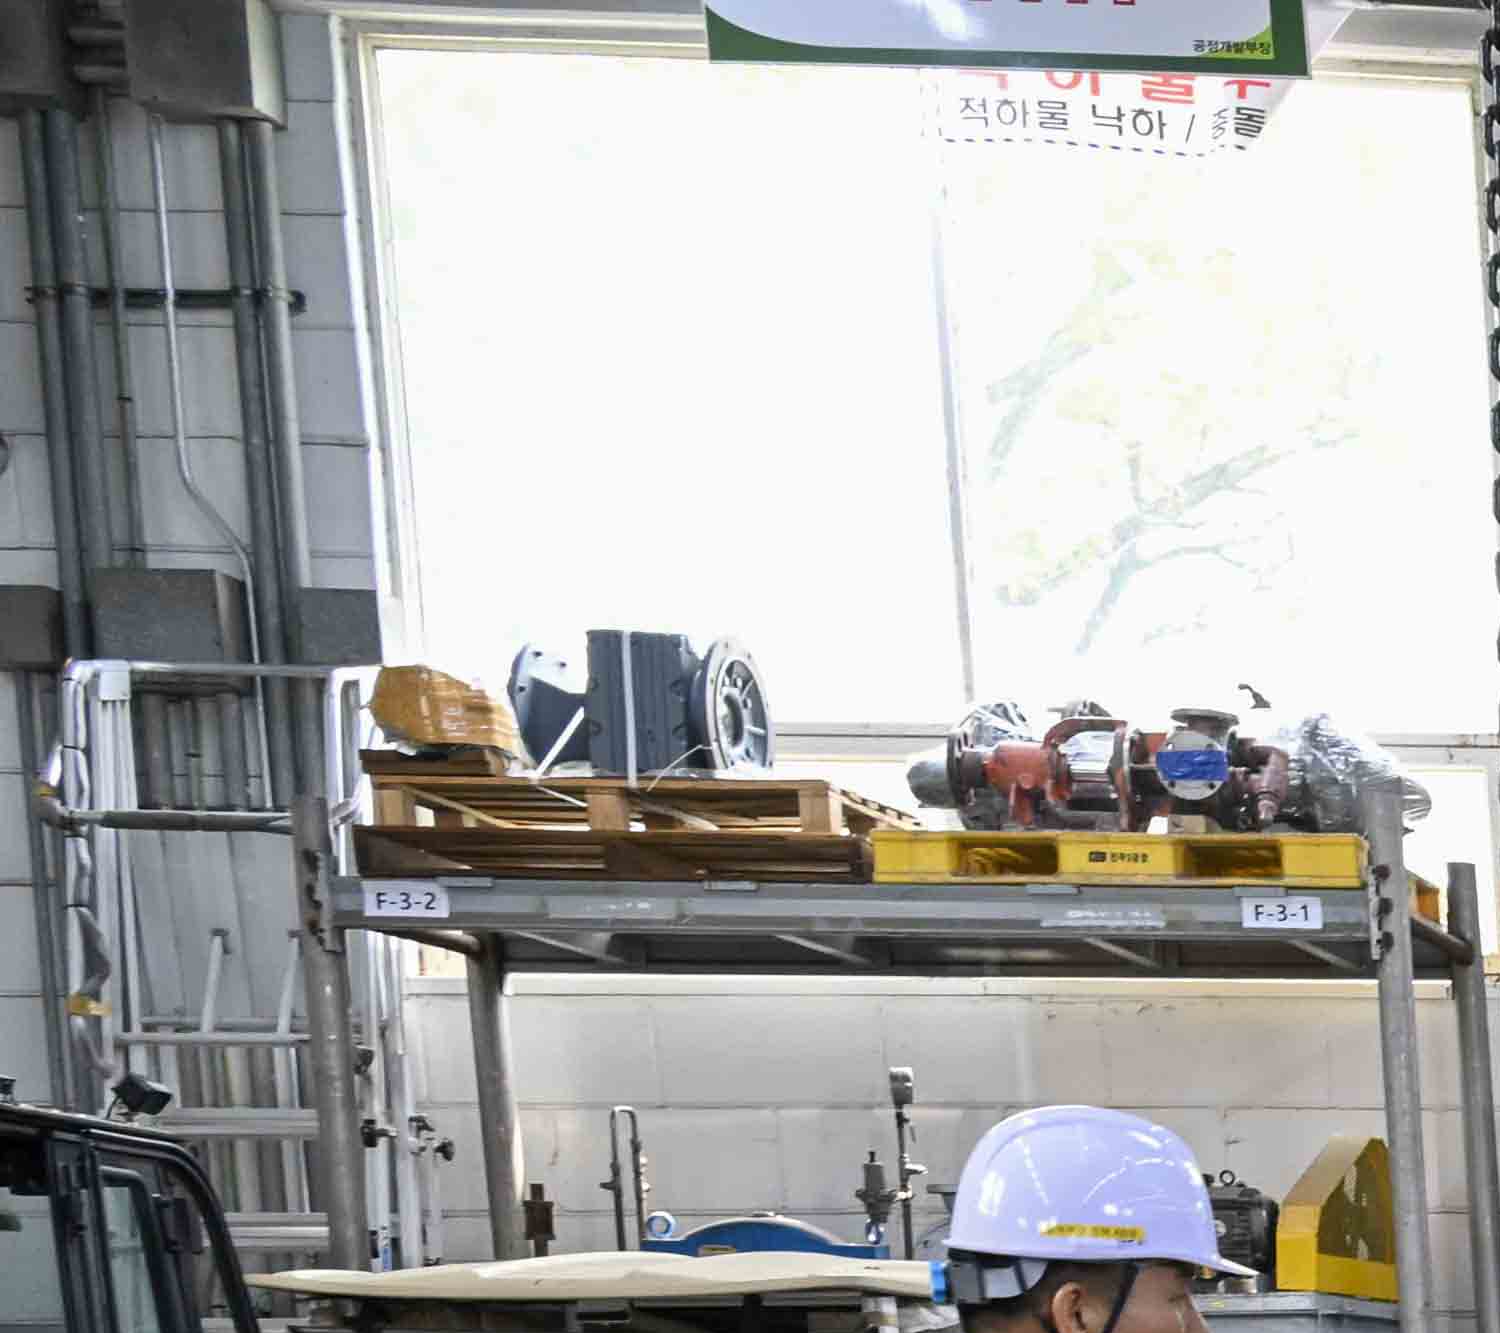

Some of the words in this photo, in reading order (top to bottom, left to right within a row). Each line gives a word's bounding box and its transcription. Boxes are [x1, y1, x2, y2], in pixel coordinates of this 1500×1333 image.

[960, 97, 1069, 130] 적하물
[1092, 104, 1166, 140] 낙하
[376, 891, 437, 911] F-3-2
[1254, 902, 1311, 925] F-3-1
